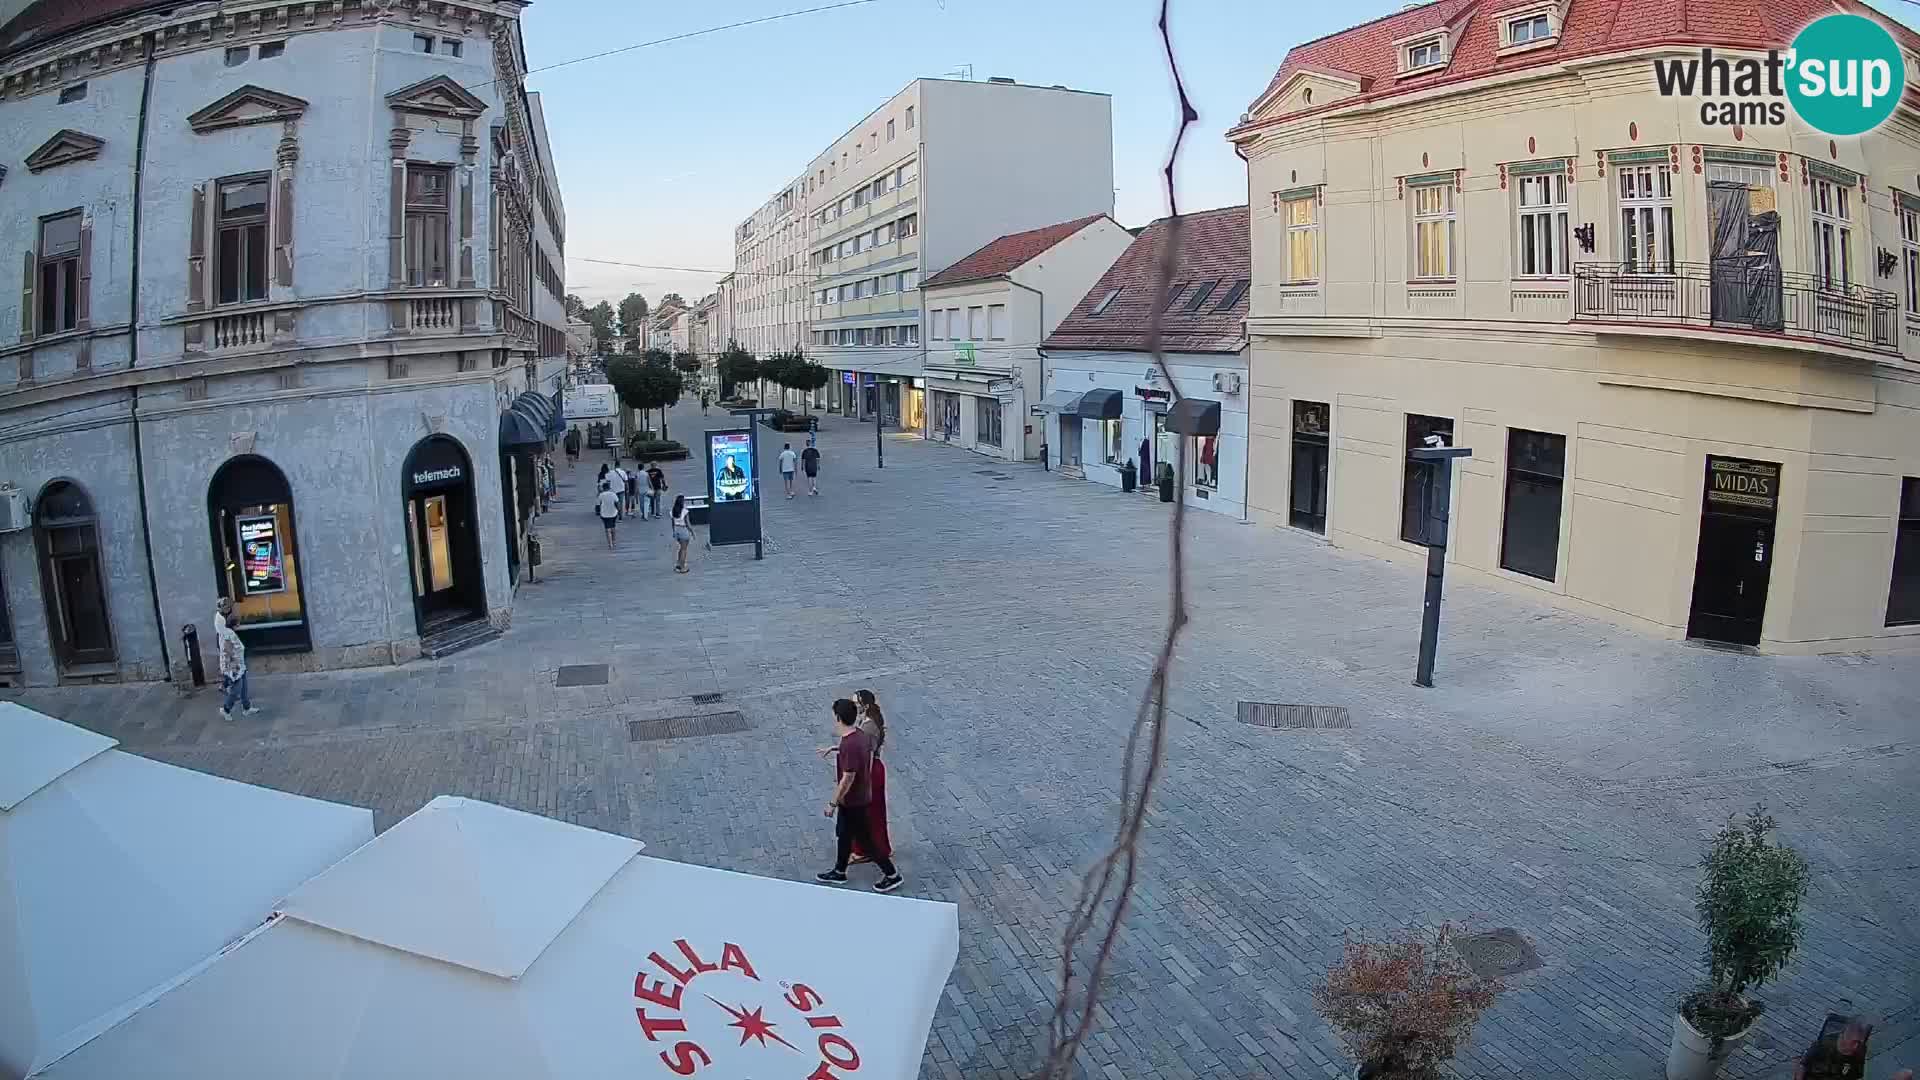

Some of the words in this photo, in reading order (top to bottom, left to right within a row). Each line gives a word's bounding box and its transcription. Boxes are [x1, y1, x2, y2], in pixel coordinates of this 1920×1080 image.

[413, 465, 460, 484] telemach
[1715, 472, 1769, 494] MIDAS
[634, 938, 760, 1075] STELLA
